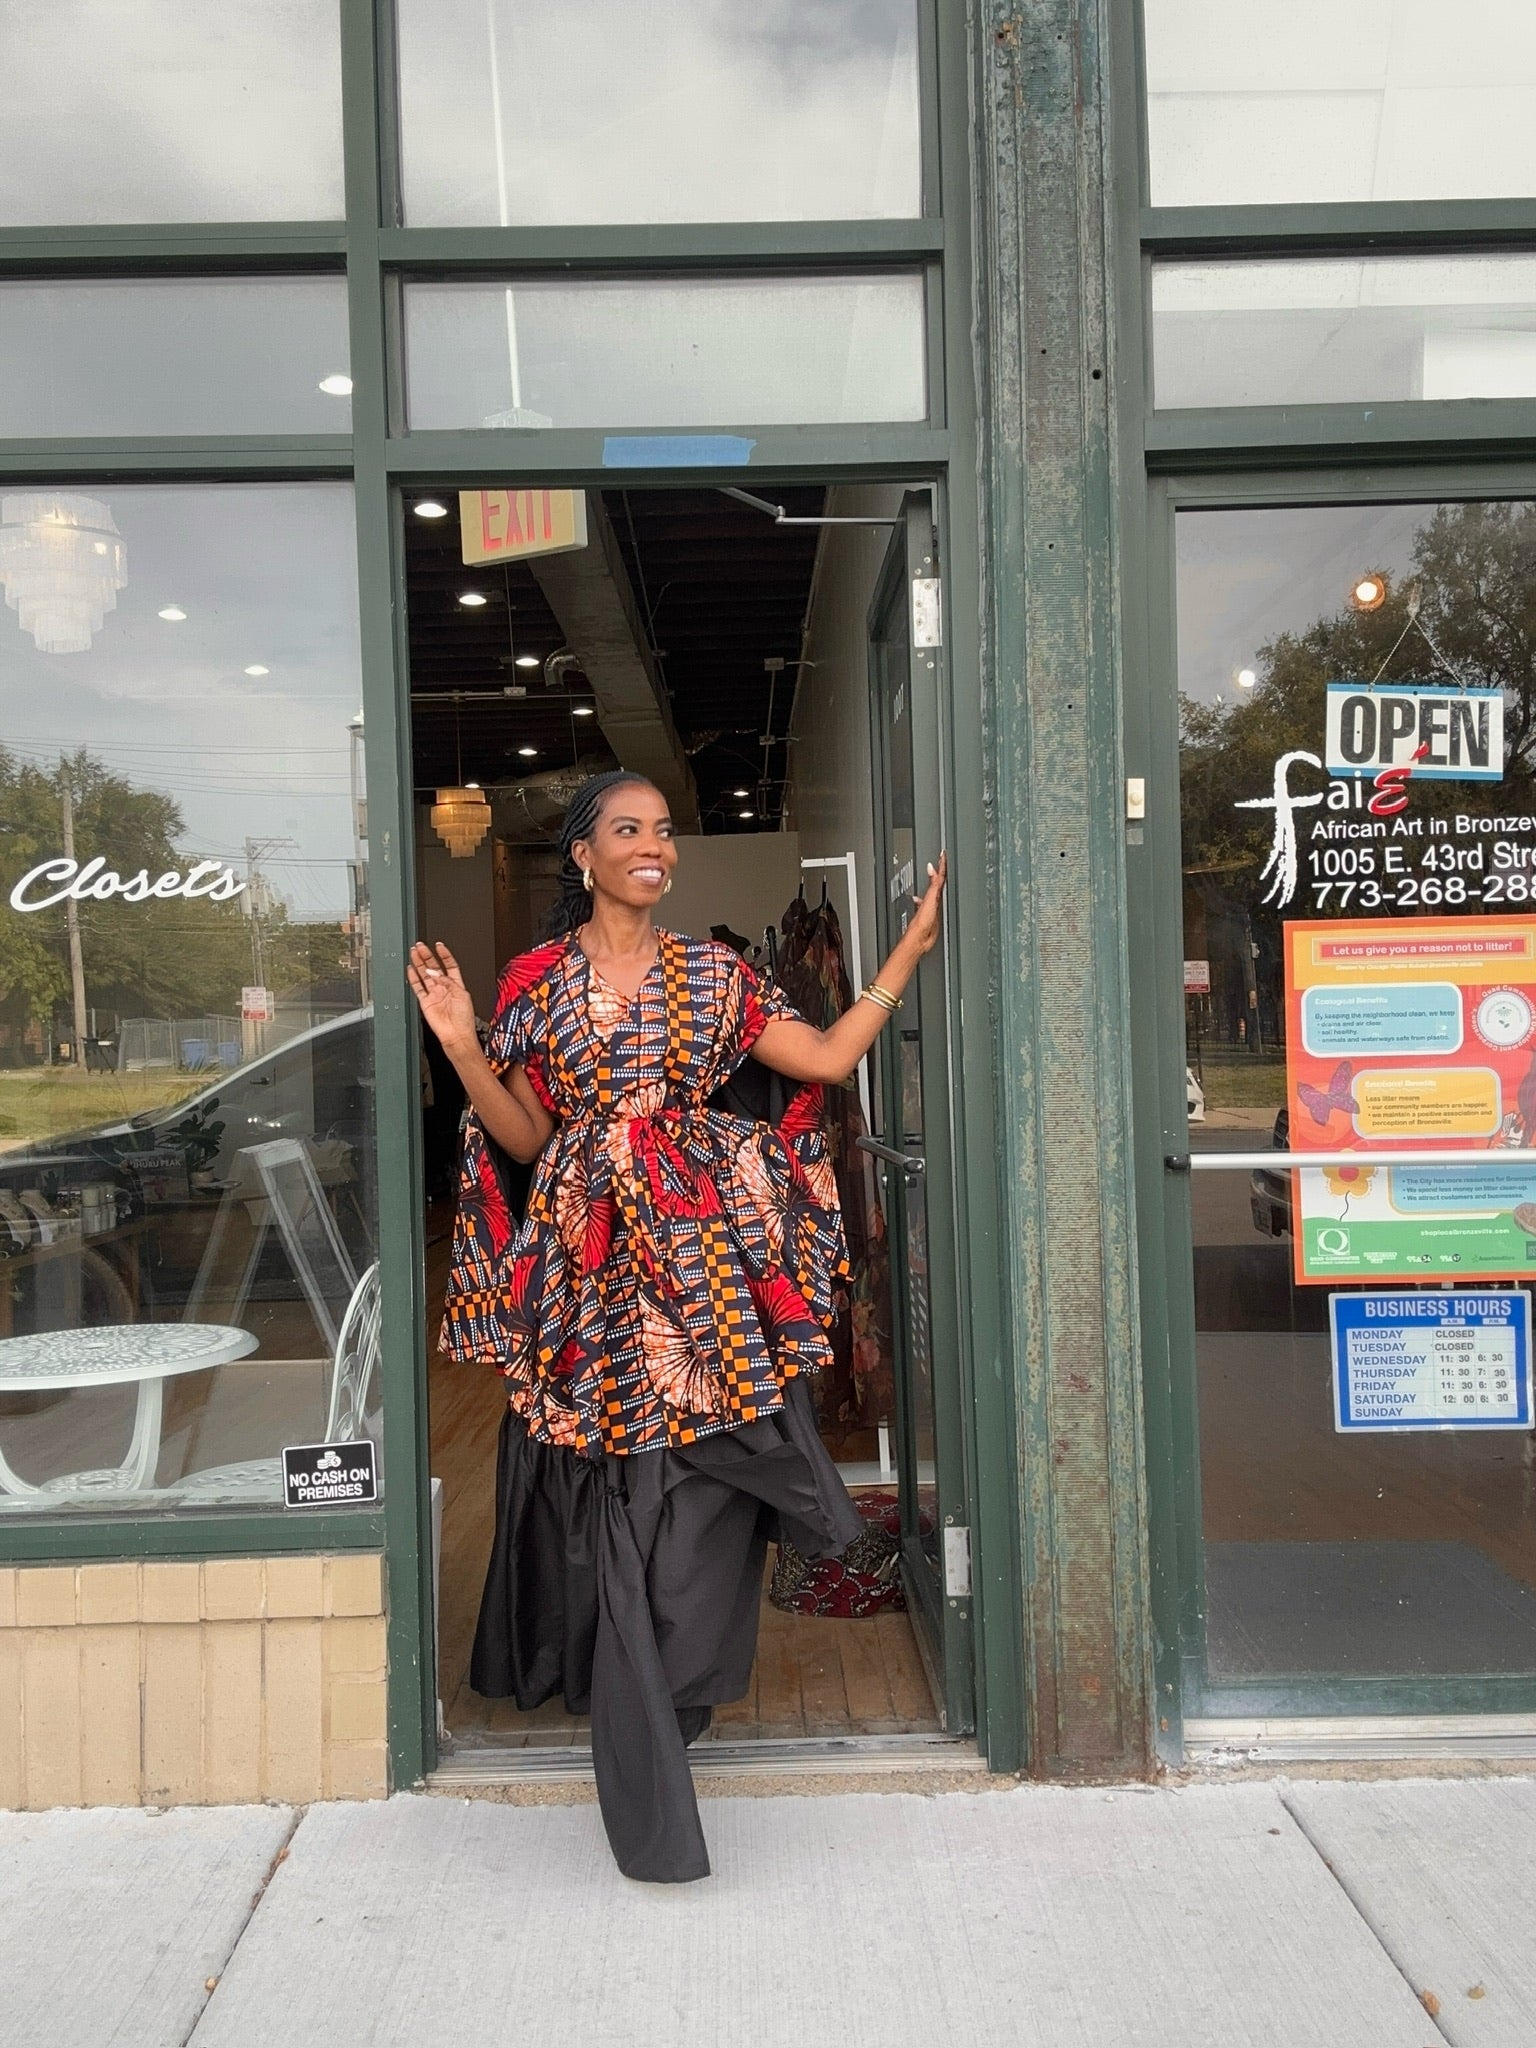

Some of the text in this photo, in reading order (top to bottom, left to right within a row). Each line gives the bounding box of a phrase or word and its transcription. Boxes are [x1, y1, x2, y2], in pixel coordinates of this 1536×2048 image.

[1340, 695, 1490, 768] OPEN
[1311, 818, 1386, 840] African
[1392, 816, 1424, 837] Art
[1430, 816, 1448, 834] in
[1308, 849, 1375, 877] 1005
[1385, 846, 1412, 874] E.
[1422, 843, 1484, 872] 43rd
[10, 856, 247, 912] Closets
[1311, 874, 1536, 909] 773-268-28
[1332, 946, 1349, 955] Let
[1352, 946, 1364, 954] us
[1366, 945, 1387, 956] give
[1389, 946, 1408, 956] you
[1456, 944, 1472, 952] not
[1473, 943, 1484, 951] to
[1485, 942, 1513, 950] litter!
[1318, 1229, 1349, 1256] Q
[1365, 1300, 1512, 1318] BUSINESS HOURS
[1352, 1330, 1475, 1340] MONDAY CLOSED
[1352, 1343, 1474, 1352] TUESDAY CLOSED
[1353, 1356, 1427, 1366] WEDNESDAY
[1354, 1368, 1416, 1378] THURSDAY
[1494, 1369, 1506, 1377] 30
[1354, 1382, 1396, 1391] FRIDAY
[1462, 1382, 1473, 1390] 30
[1354, 1394, 1416, 1404] SATURDAY
[1463, 1395, 1474, 1403] 00
[1497, 1394, 1508, 1402] 30
[1355, 1408, 1403, 1417] SUNDAY
[290, 1468, 370, 1488] NO CASH ON
[298, 1483, 364, 1500] PREMISES
